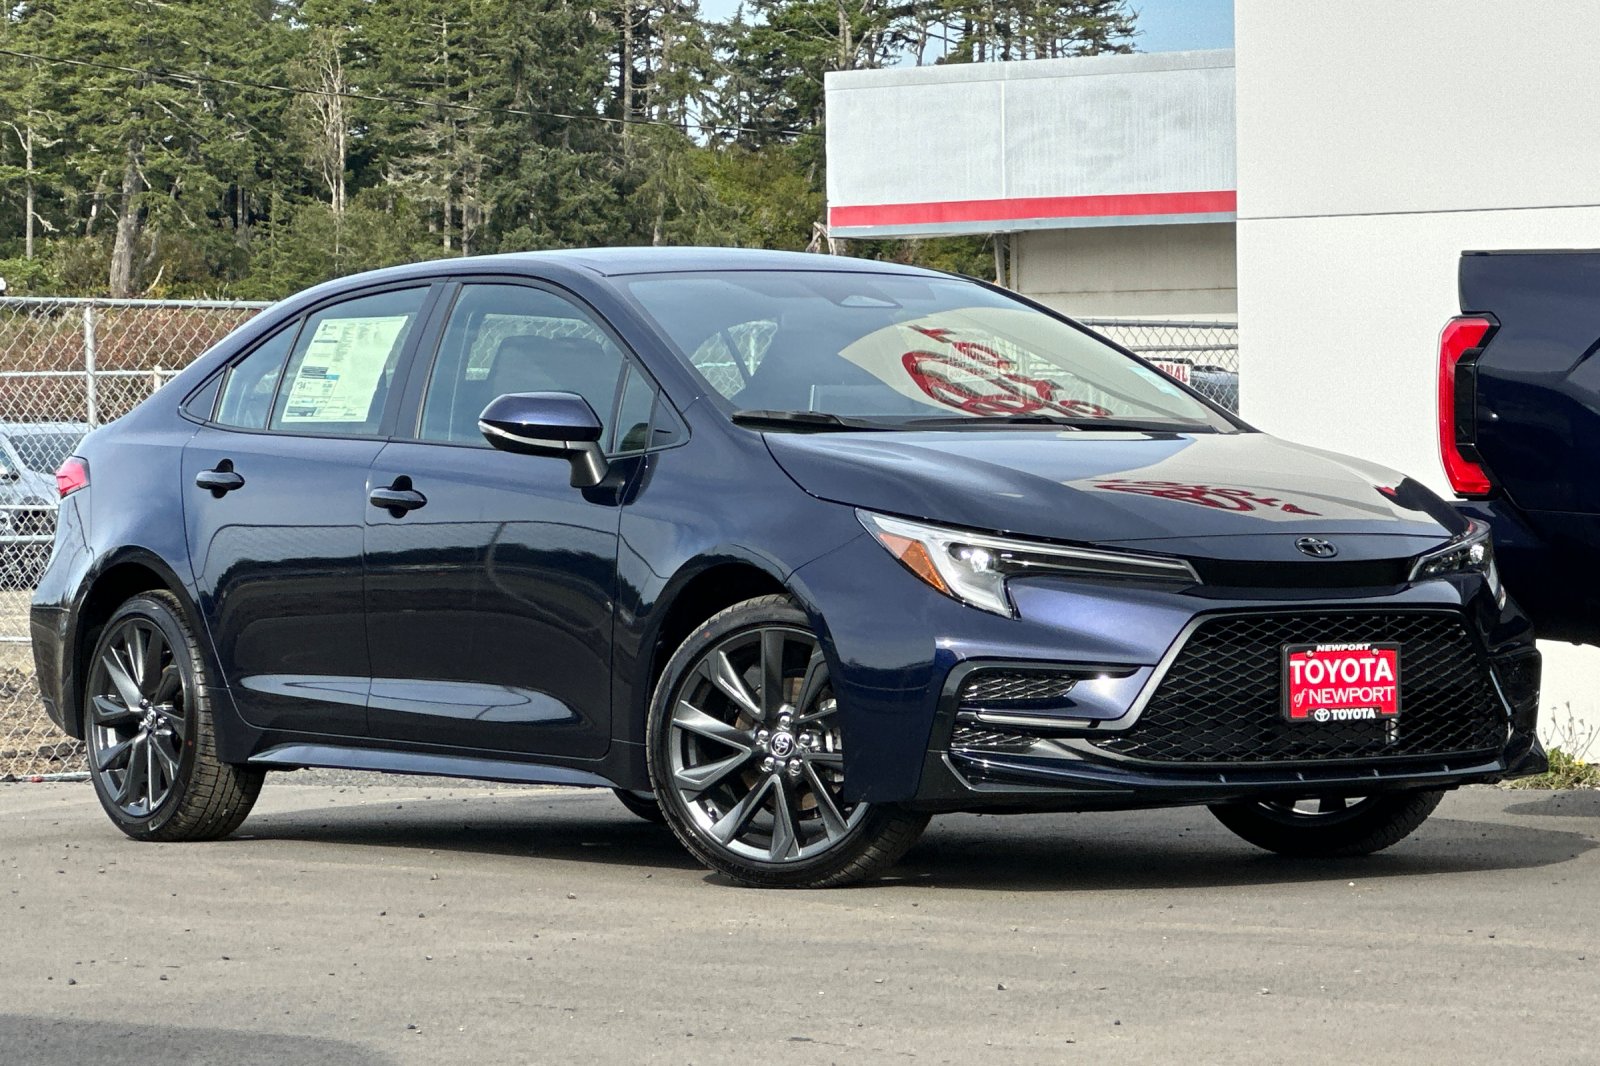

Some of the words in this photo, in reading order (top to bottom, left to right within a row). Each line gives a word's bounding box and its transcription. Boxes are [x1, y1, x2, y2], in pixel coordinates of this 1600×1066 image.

[1316, 643, 1371, 652] NEWPORT
[1290, 657, 1394, 685] TOYOTA
[1294, 687, 1308, 707] of
[1309, 686, 1396, 704] NEWPORT
[1331, 708, 1377, 720] TOYOTA
